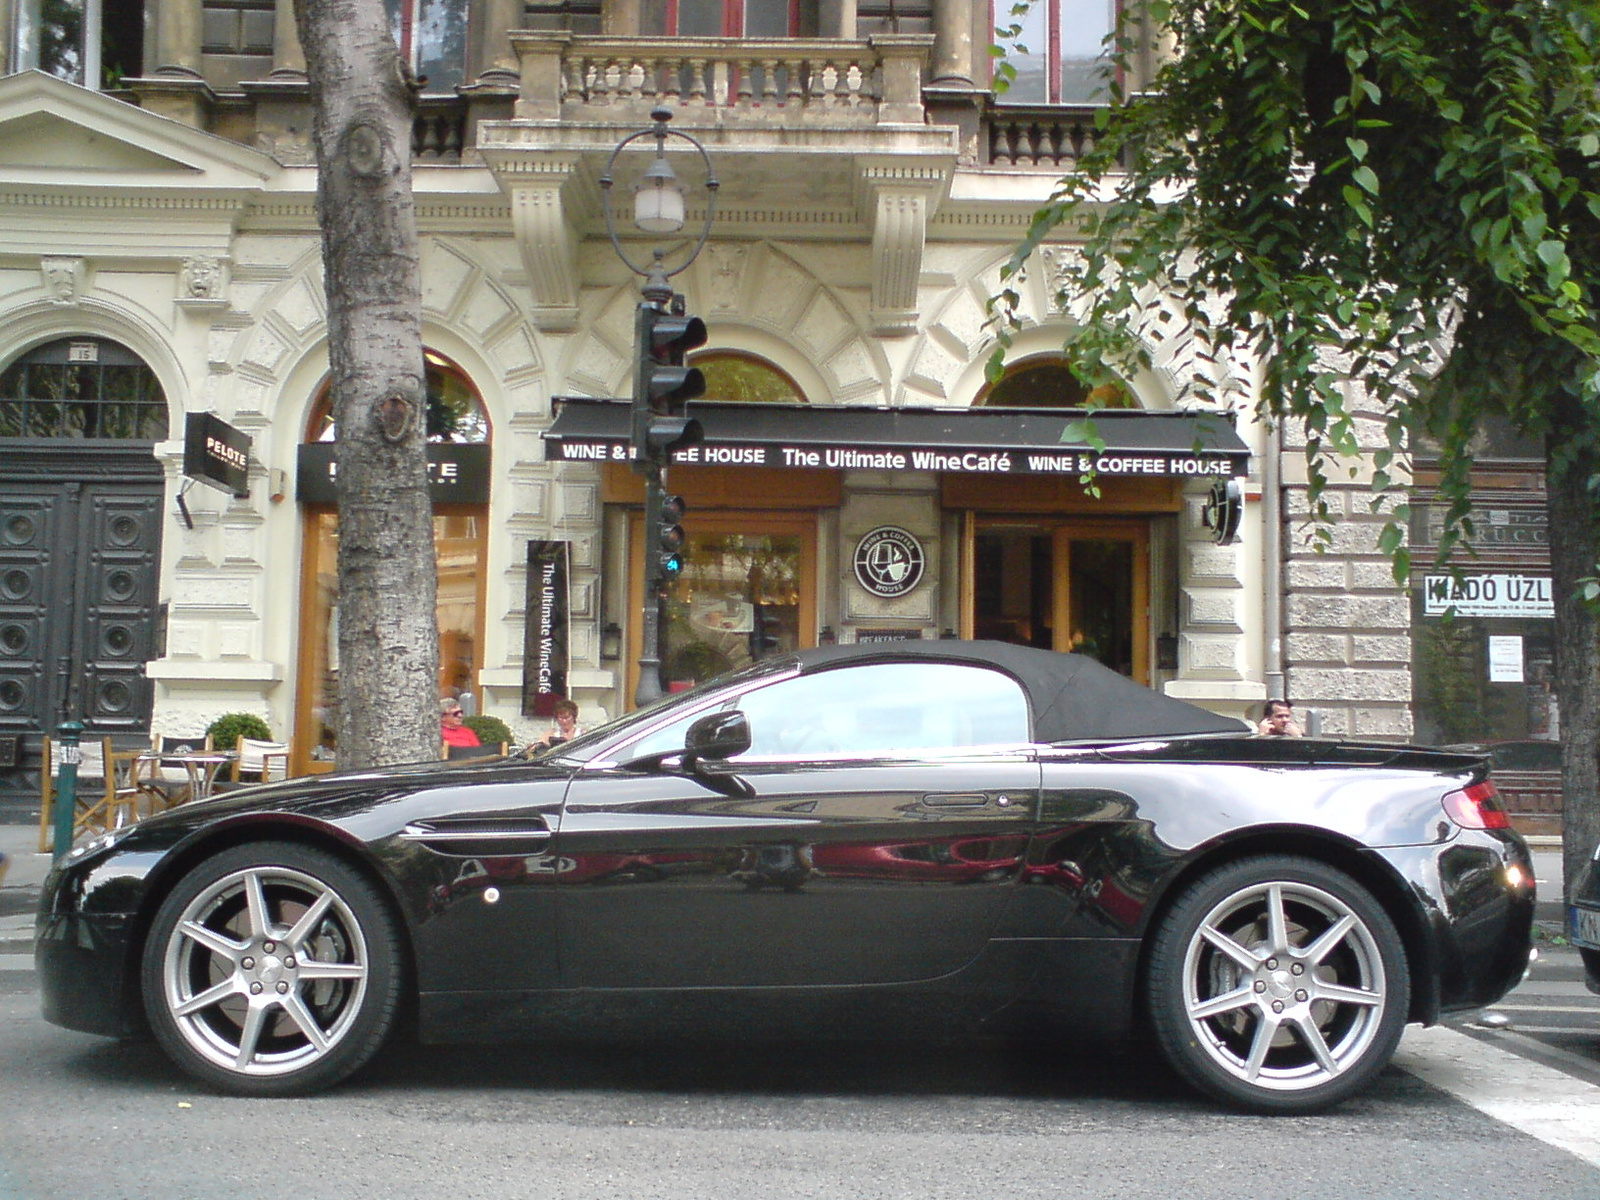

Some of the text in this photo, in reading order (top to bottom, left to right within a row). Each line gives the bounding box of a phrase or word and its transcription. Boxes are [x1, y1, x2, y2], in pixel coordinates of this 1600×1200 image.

[207, 436, 247, 466] PELOTE
[563, 445, 606, 459] WINE
[612, 445, 626, 460] &
[705, 448, 765, 463] HOUSE
[782, 448, 1012, 472] The Ultimate WineCafé
[1028, 456, 1232, 475] WINE & COFFEE HOUSE
[862, 534, 881, 551] WINE
[890, 532, 915, 550] COFFEE
[875, 583, 904, 593] HOUSE
[538, 562, 555, 694] The Ultimate WineCafé
